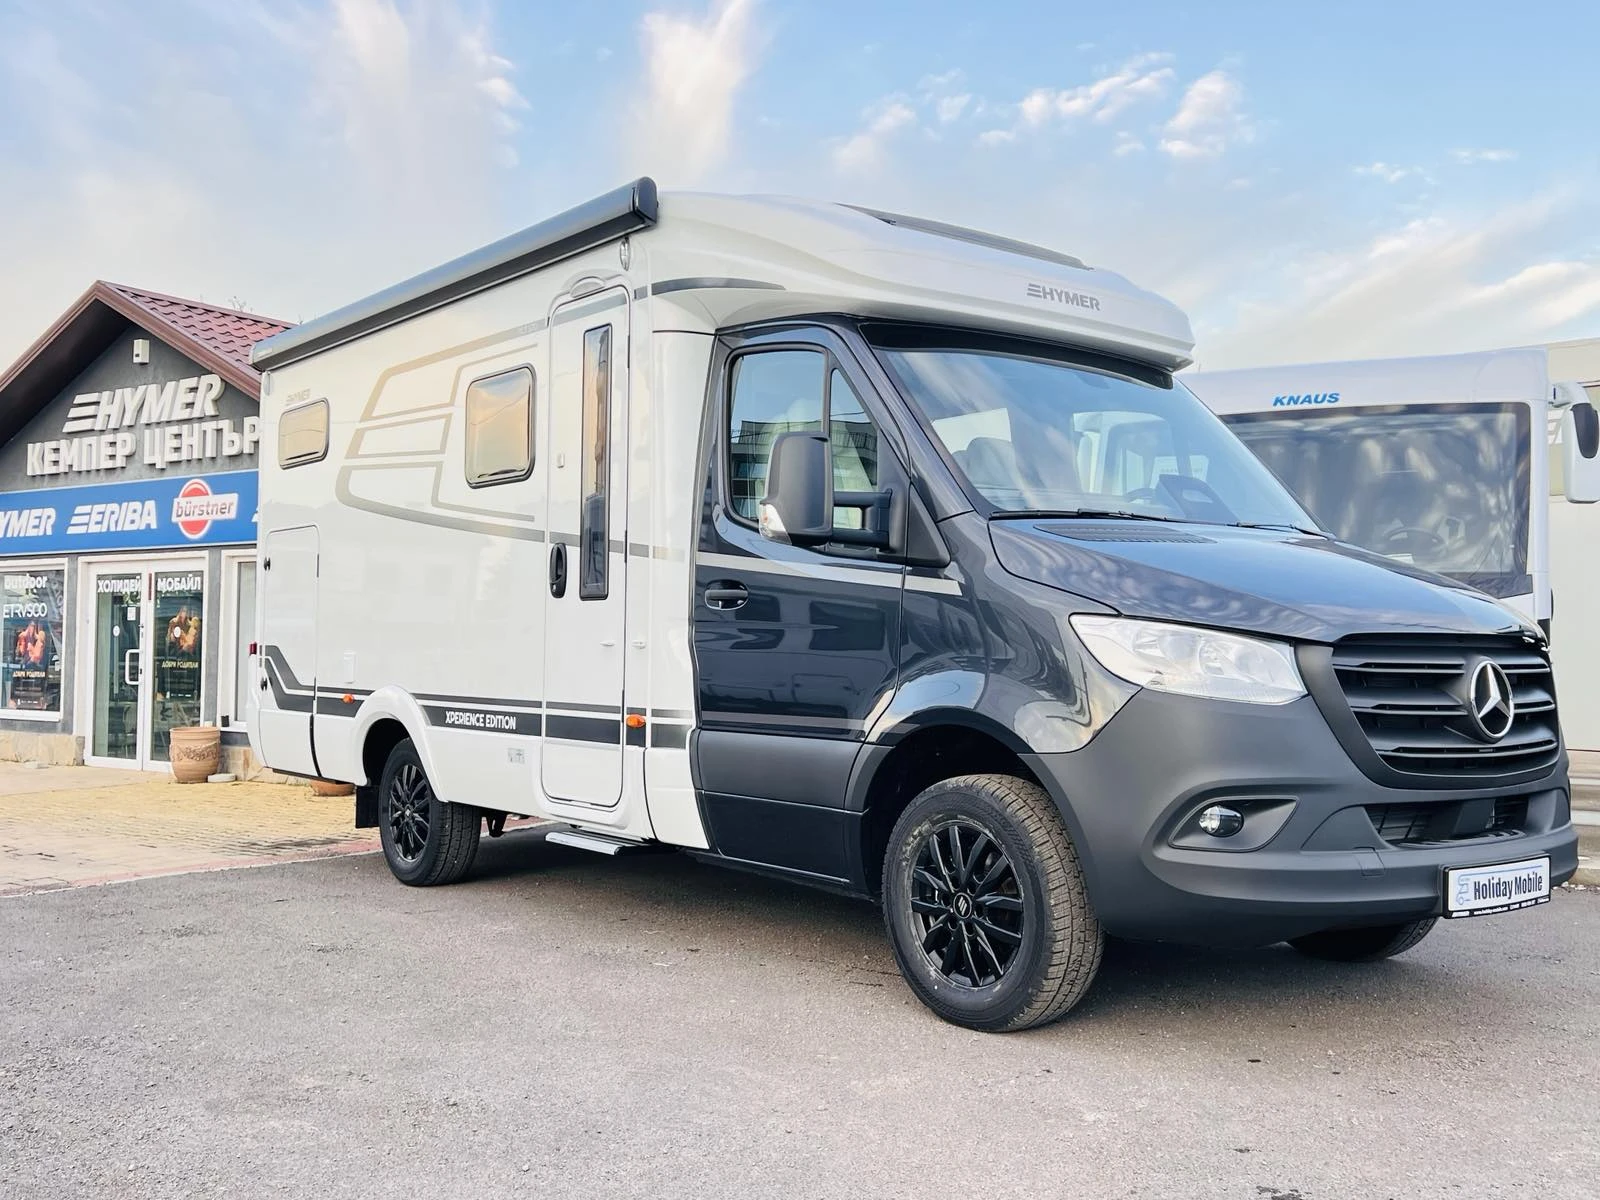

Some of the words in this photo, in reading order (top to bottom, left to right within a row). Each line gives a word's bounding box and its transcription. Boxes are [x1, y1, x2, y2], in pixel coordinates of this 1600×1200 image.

[1041, 285, 1101, 311] HYMER
[94, 374, 223, 431] HYMER
[1272, 392, 1340, 407] KNAUS
[27, 432, 136, 476] КЕМПЕР
[144, 416, 260, 469] ЦЕНТЪР
[88, 500, 157, 533] ERIBA
[176, 500, 234, 518] bürstner
[97, 576, 141, 593] ХОЛИДЕЙ
[157, 574, 201, 592] МОБАЙЛ
[445, 711, 484, 727] XPERIENCE
[485, 714, 516, 730] EDITION
[1473, 877, 1513, 901] Holiday
[1515, 871, 1543, 894] Mobile
